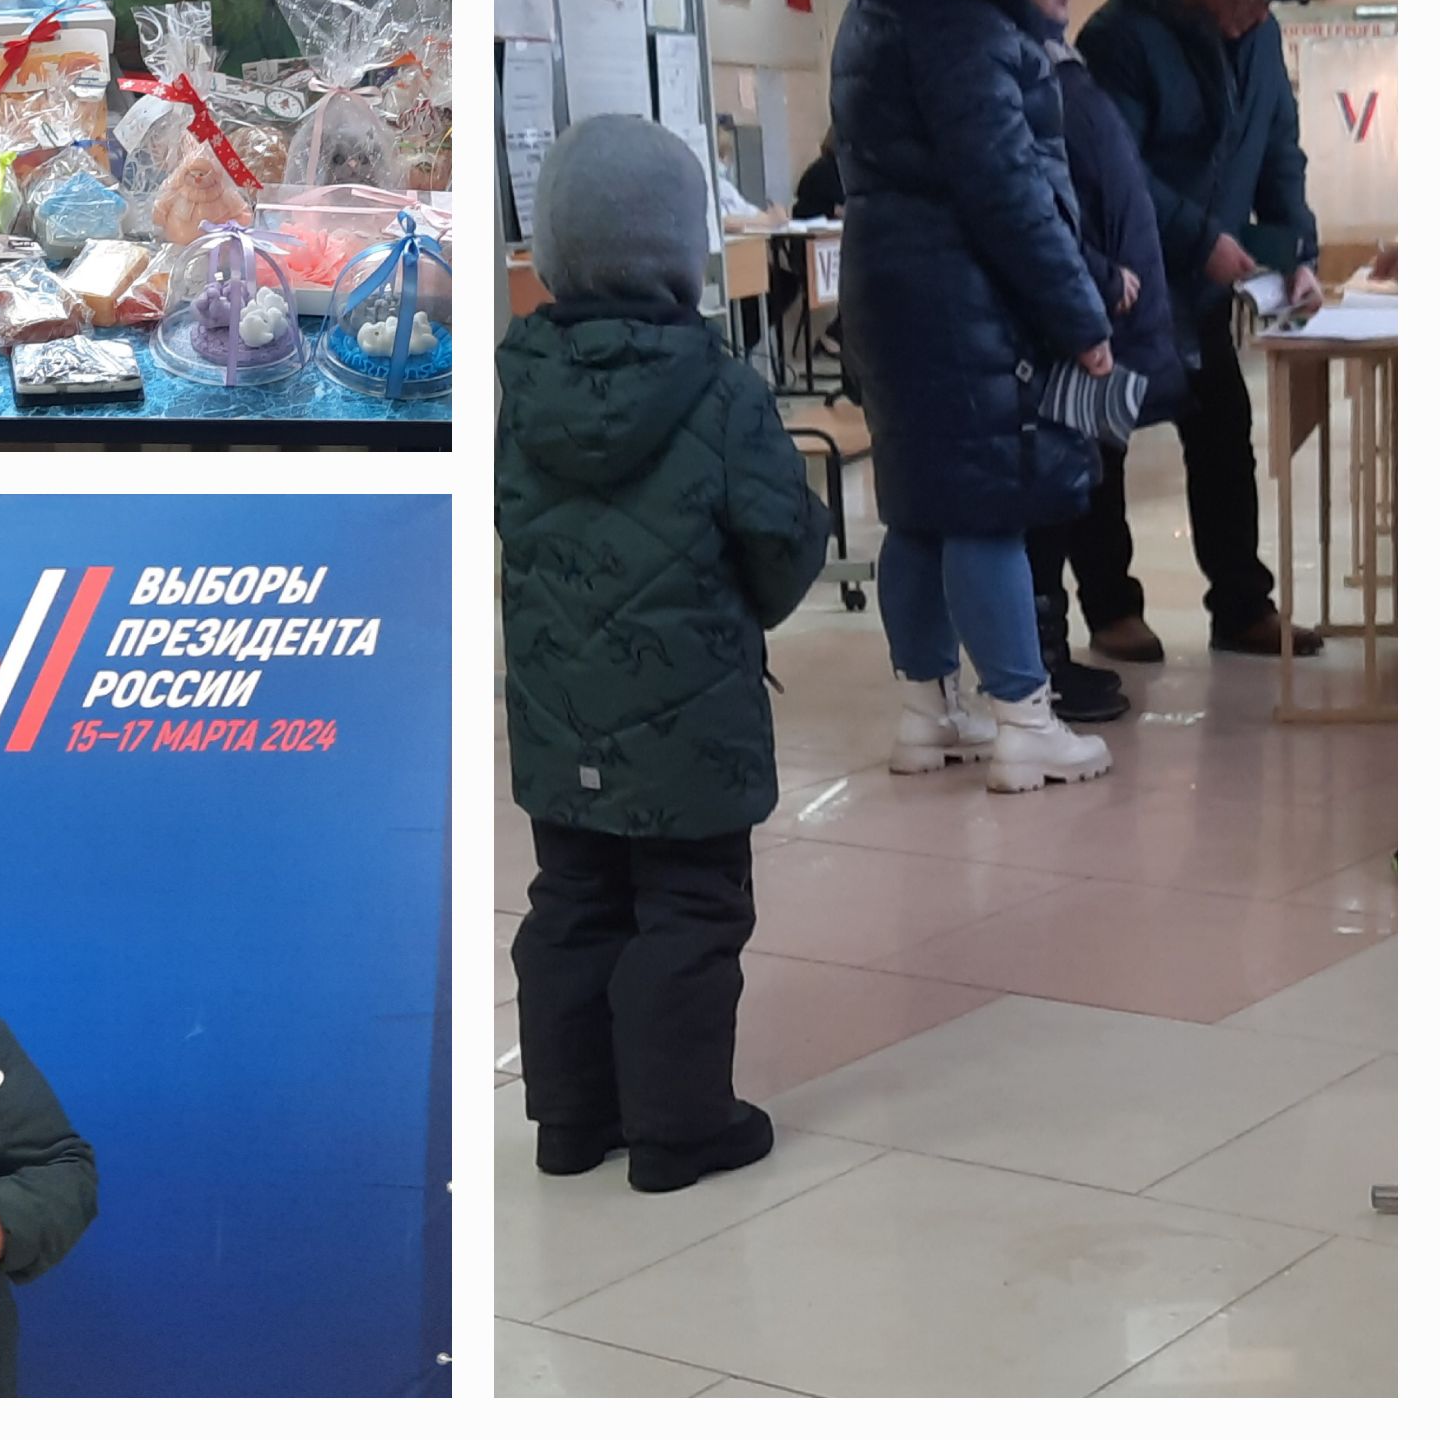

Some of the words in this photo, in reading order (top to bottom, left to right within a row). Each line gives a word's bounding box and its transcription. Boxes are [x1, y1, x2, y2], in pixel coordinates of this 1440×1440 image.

[129, 566, 329, 606] ВЫБОРЫ
[105, 618, 382, 662] ПРЕЗИДЕНТА
[81, 669, 262, 708] РОССИИ
[151, 720, 259, 752] МАРТА
[261, 720, 338, 752] 2024
